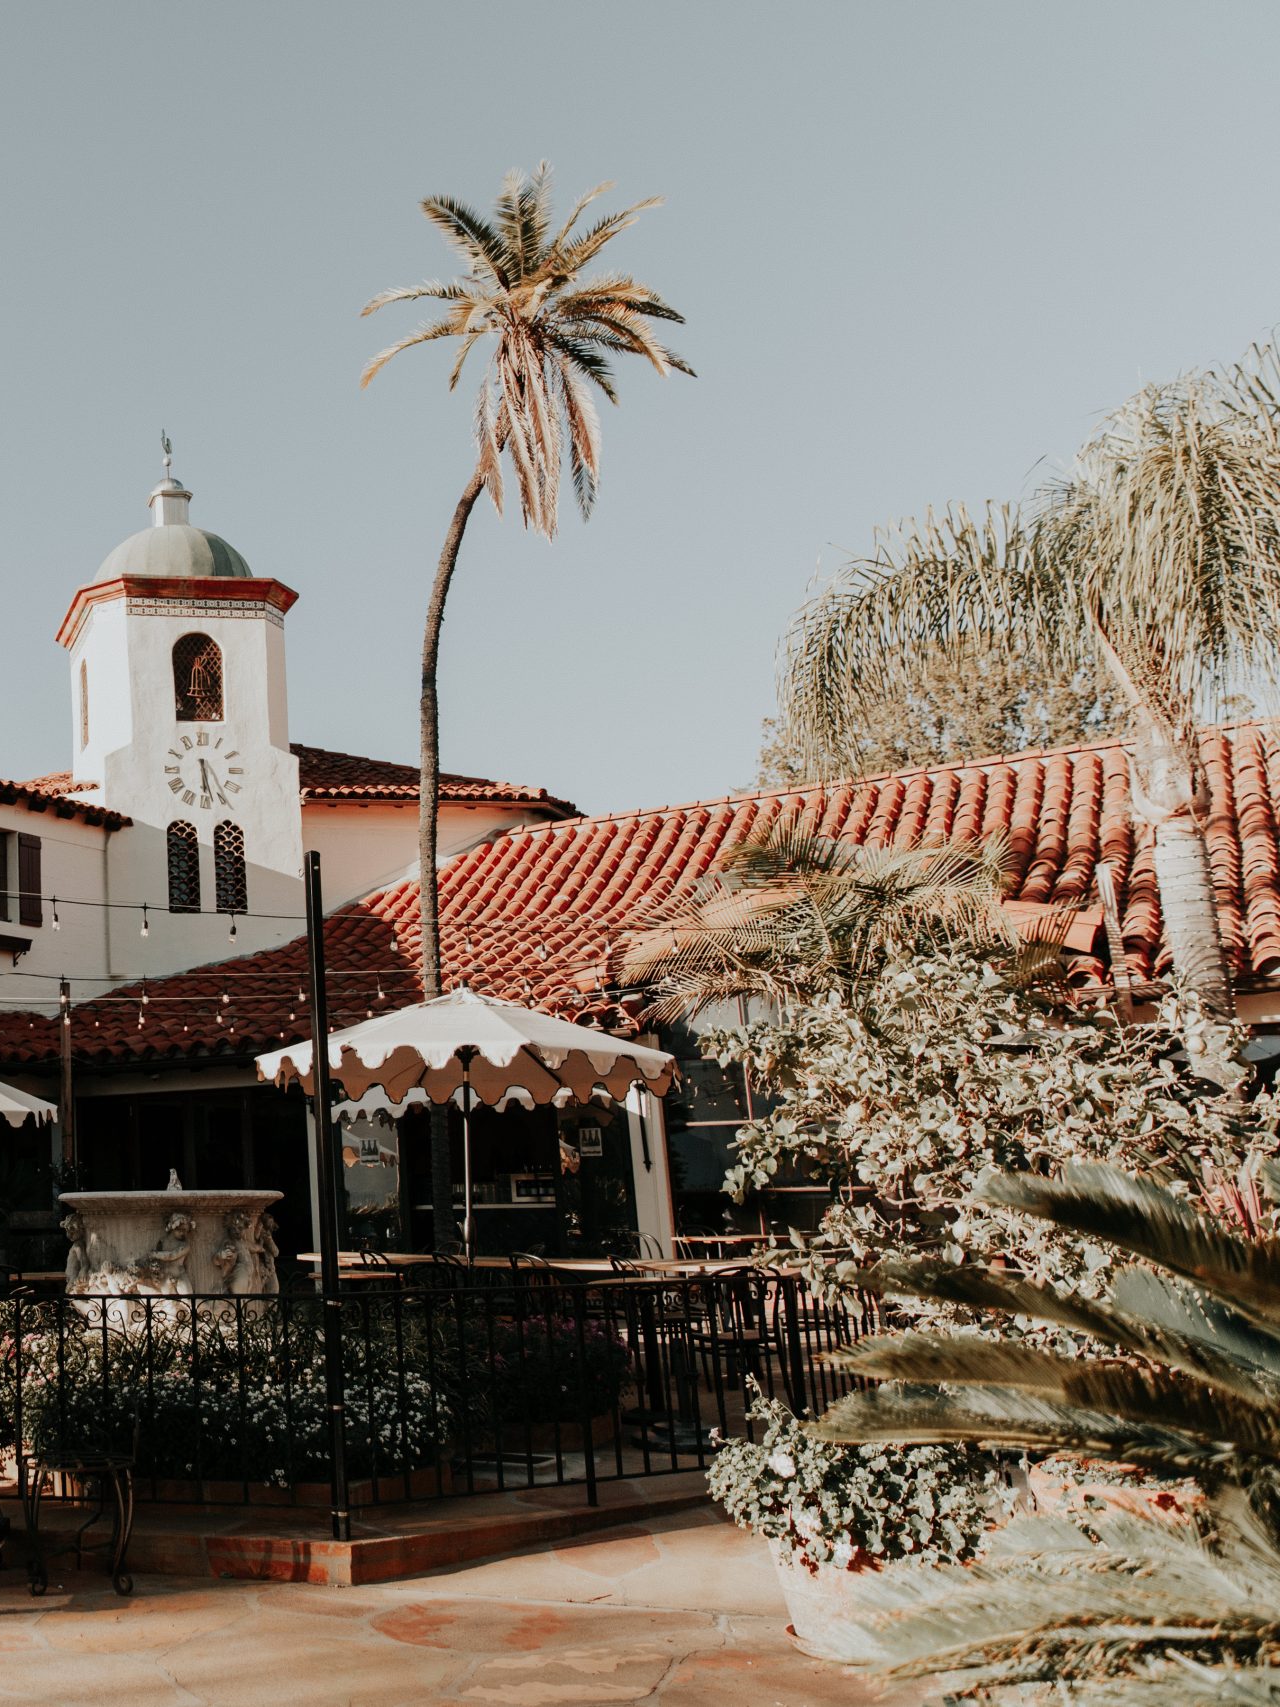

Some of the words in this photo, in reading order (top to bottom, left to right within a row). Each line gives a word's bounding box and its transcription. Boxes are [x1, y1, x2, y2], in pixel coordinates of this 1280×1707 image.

[180, 735, 193, 750] XI
[215, 737, 223, 749] I
[167, 748, 184, 759] X
[164, 765, 180, 774] IX
[217, 792, 226, 805] V
